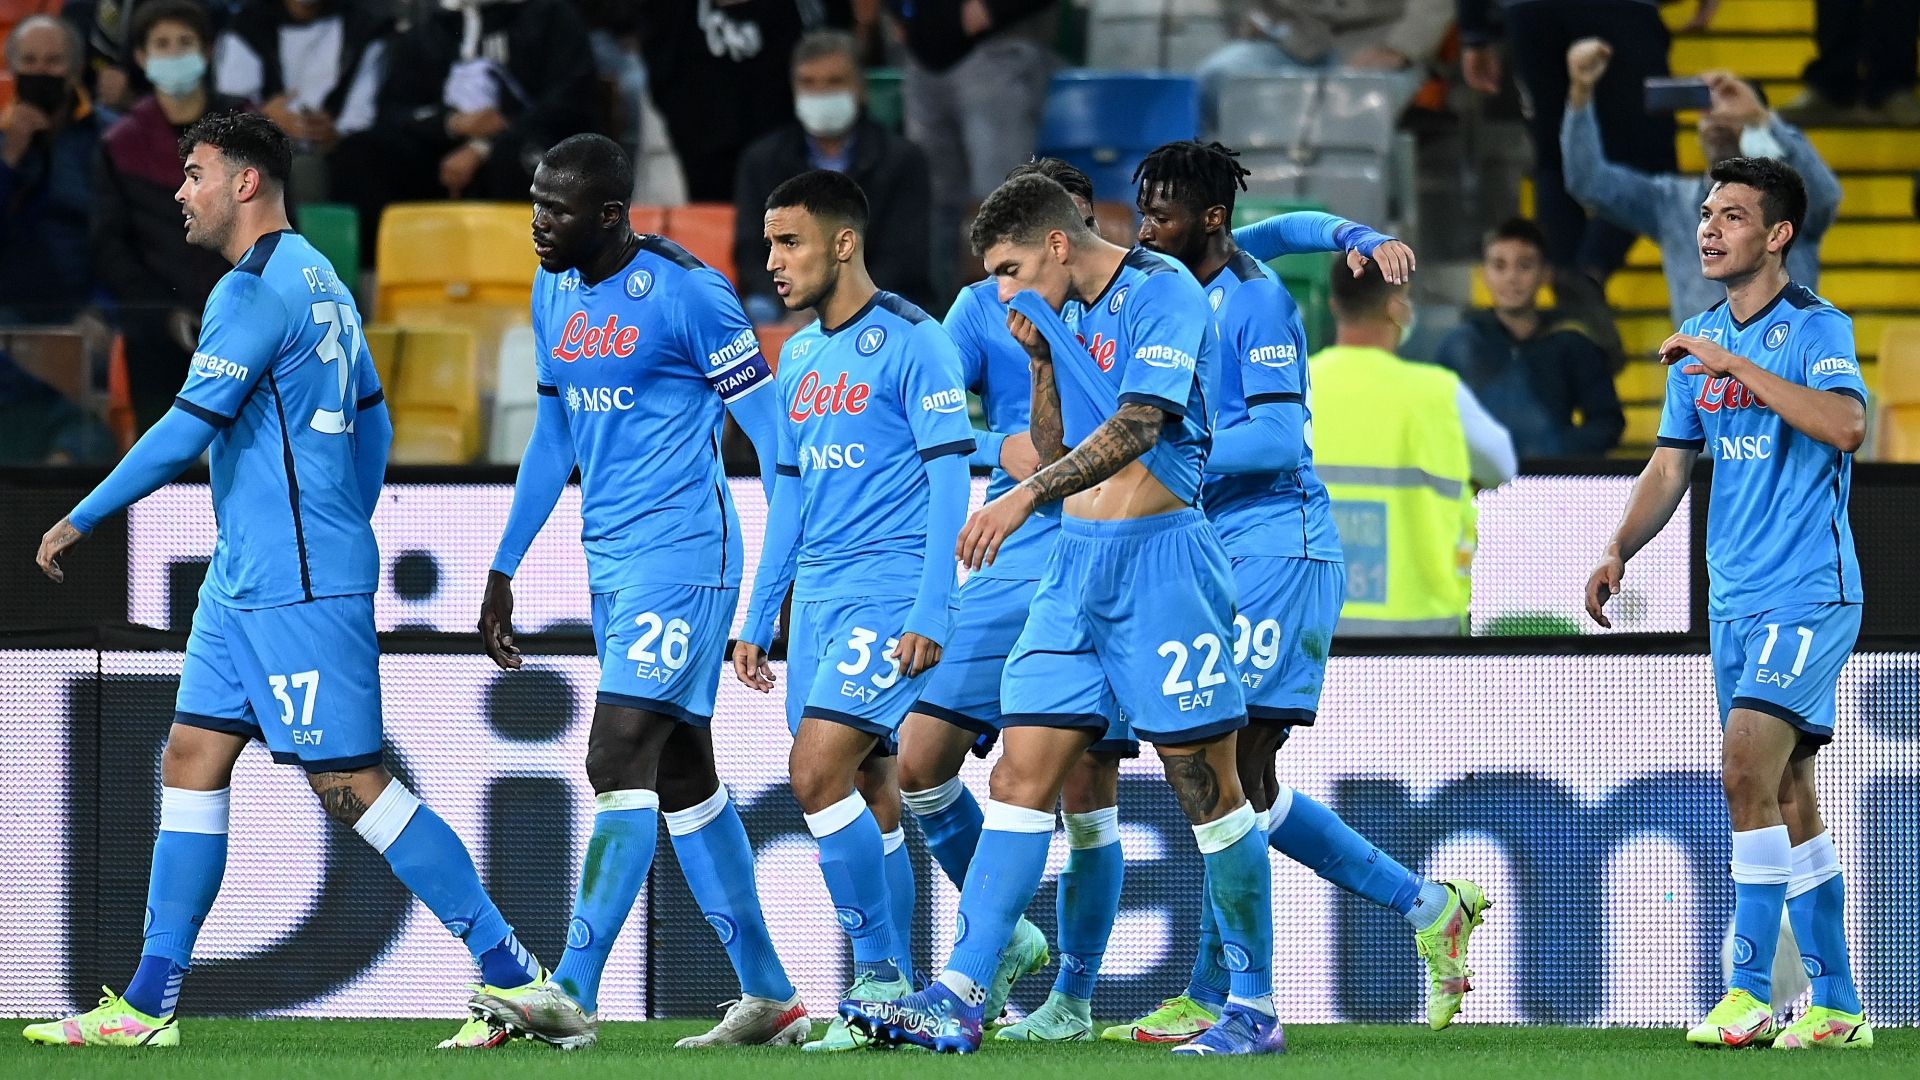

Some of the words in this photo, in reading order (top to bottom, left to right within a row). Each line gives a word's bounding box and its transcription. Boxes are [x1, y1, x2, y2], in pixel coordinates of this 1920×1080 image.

[558, 276, 581, 292] EA7
[552, 310, 640, 362] Lete
[790, 338, 813, 360] EA7
[191, 351, 249, 382] amazon
[309, 300, 361, 435] 37
[1135, 343, 1194, 372] amazon
[1249, 344, 1298, 365] amaz
[583, 386, 635, 413] MSC
[788, 370, 871, 424] Lete
[810, 443, 866, 471] MSC
[1719, 434, 1771, 461] MSC
[626, 611, 692, 670] 26
[1757, 623, 1814, 678] 11
[636, 662, 675, 685] EA7
[1157, 632, 1227, 697] 22
[839, 680, 879, 705] EA7
[1240, 672, 1264, 690] A7
[1755, 668, 1796, 690] EA7
[267, 669, 320, 726] 37
[1177, 689, 1215, 713] EA7
[292, 729, 323, 746] EA7
[1366, 848, 1380, 865] EA
